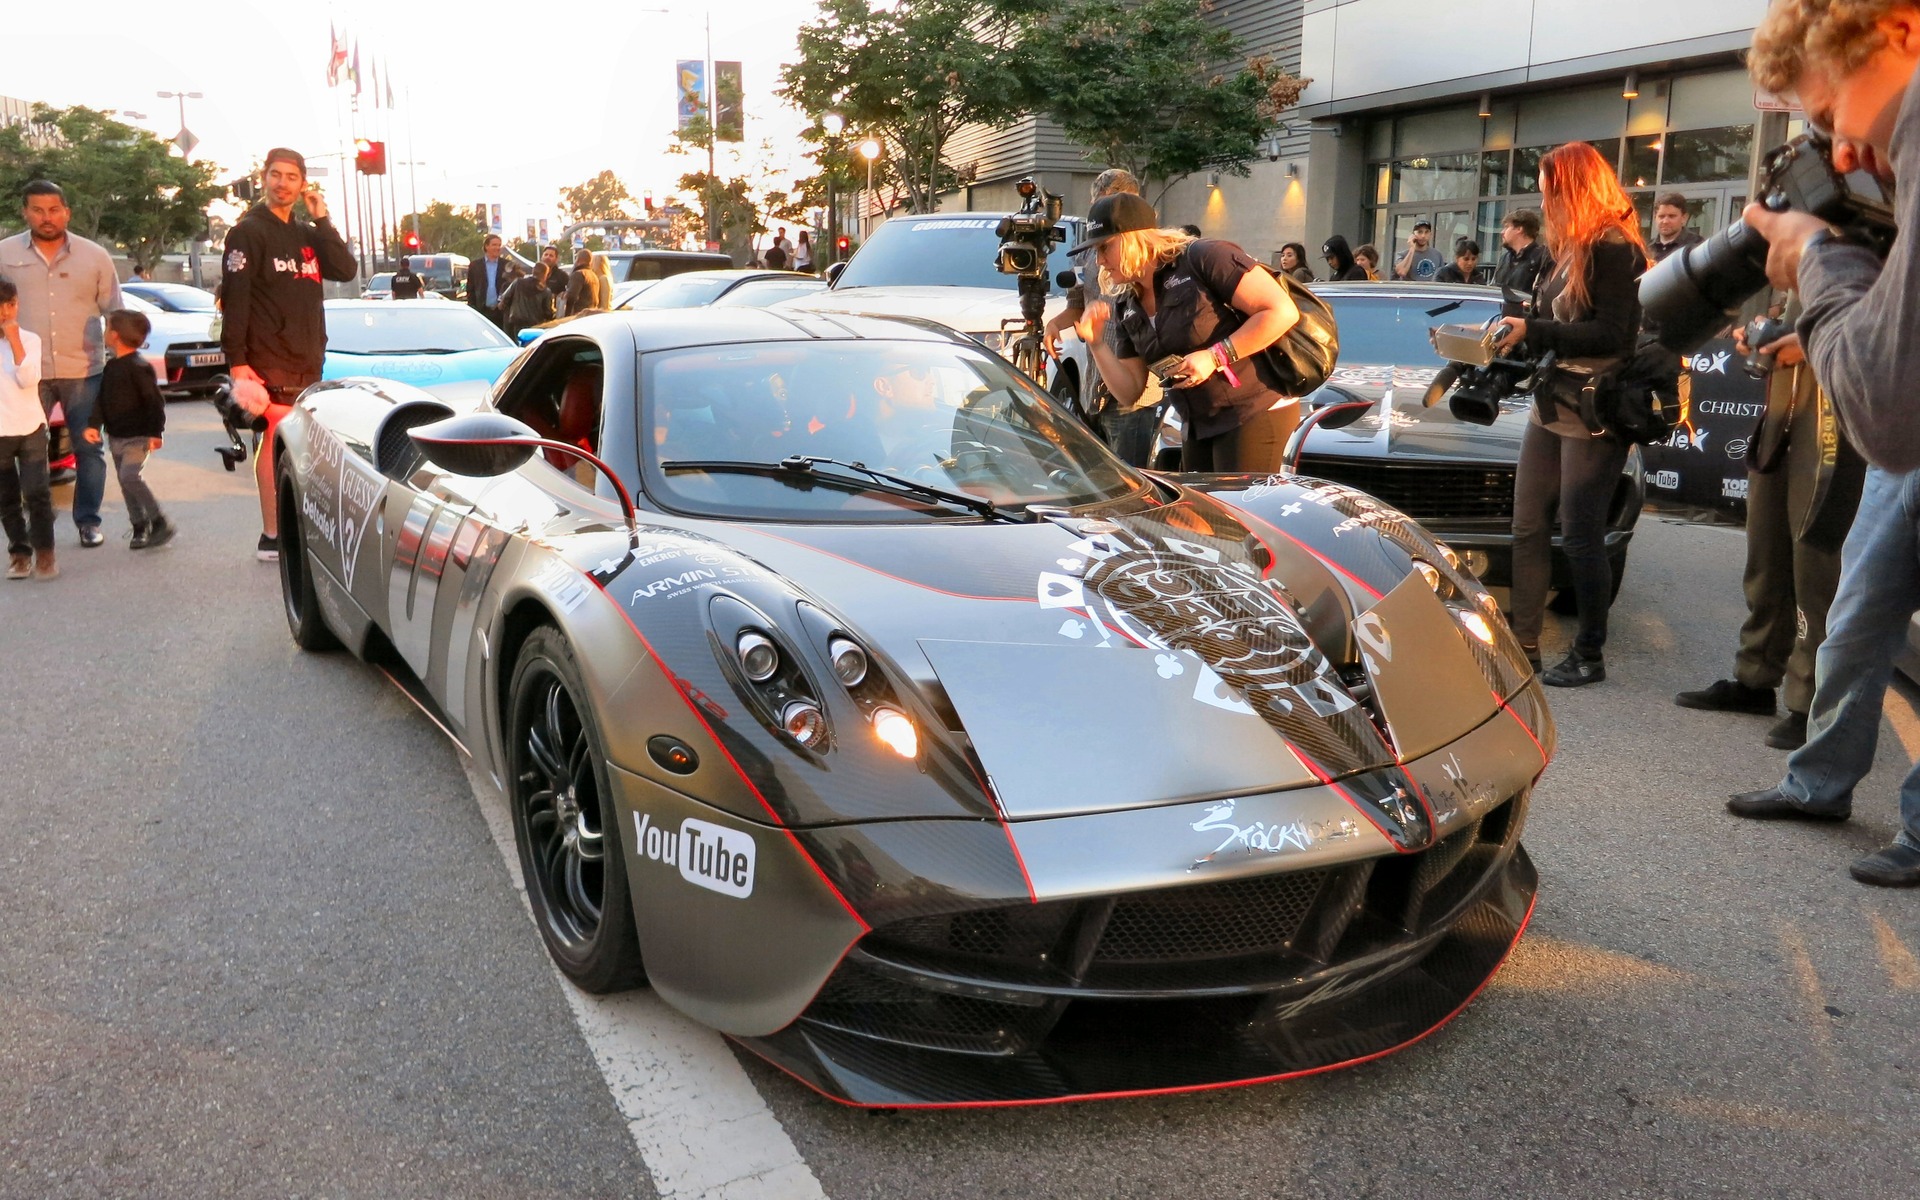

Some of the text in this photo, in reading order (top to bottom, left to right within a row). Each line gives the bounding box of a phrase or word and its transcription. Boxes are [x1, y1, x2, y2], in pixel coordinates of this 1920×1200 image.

[911, 219, 984, 231] GUMBALL
[308, 420, 342, 468] GUESS
[342, 468, 375, 512] GUESS
[1722, 478, 1747, 490] TOP
[639, 549, 682, 567] ENERGY
[631, 567, 716, 606] ARMIN
[666, 587, 693, 599] SWISS
[633, 811, 748, 887] YouTube
